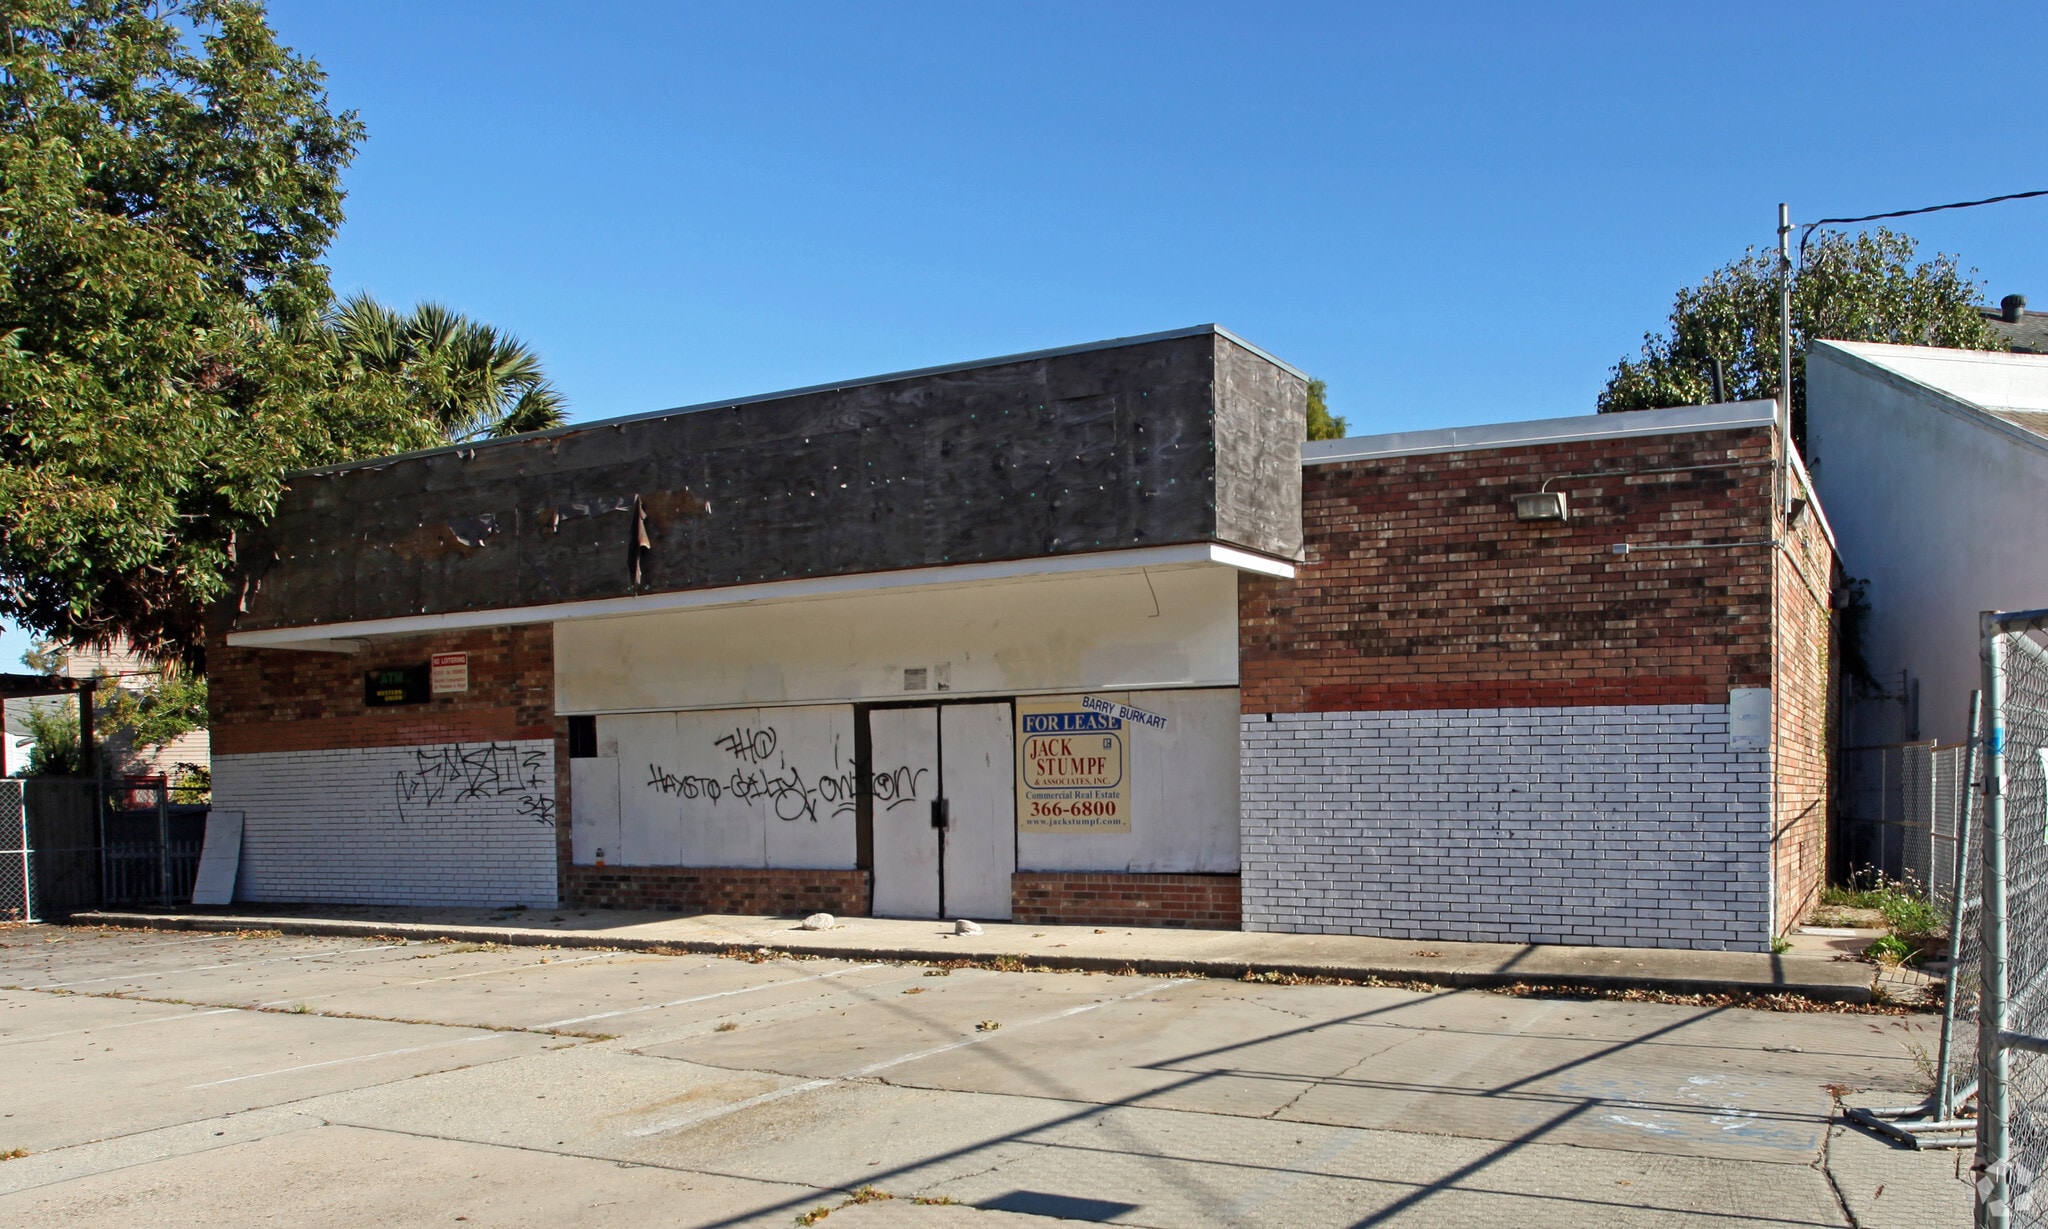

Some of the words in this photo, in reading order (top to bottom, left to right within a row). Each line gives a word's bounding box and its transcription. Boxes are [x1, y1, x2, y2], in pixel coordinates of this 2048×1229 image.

[381, 672, 404, 684] ATM
[1082, 696, 1115, 714] BARRY
[1119, 706, 1167, 729] BURKART
[1026, 715, 1060, 732] FOR
[1063, 714, 1119, 731] LEASE
[1030, 738, 1073, 760] JACK
[1037, 757, 1107, 776] STUMPF
[1042, 778, 1093, 786] ASSOCIATES,
[1093, 777, 1111, 785] INC.
[1025, 791, 1073, 800] Commercial
[1074, 790, 1093, 799] Real
[1095, 790, 1120, 799] Estate
[1030, 801, 1116, 817] 366-6800
[1026, 818, 1121, 827] www.jackstumpf.com
